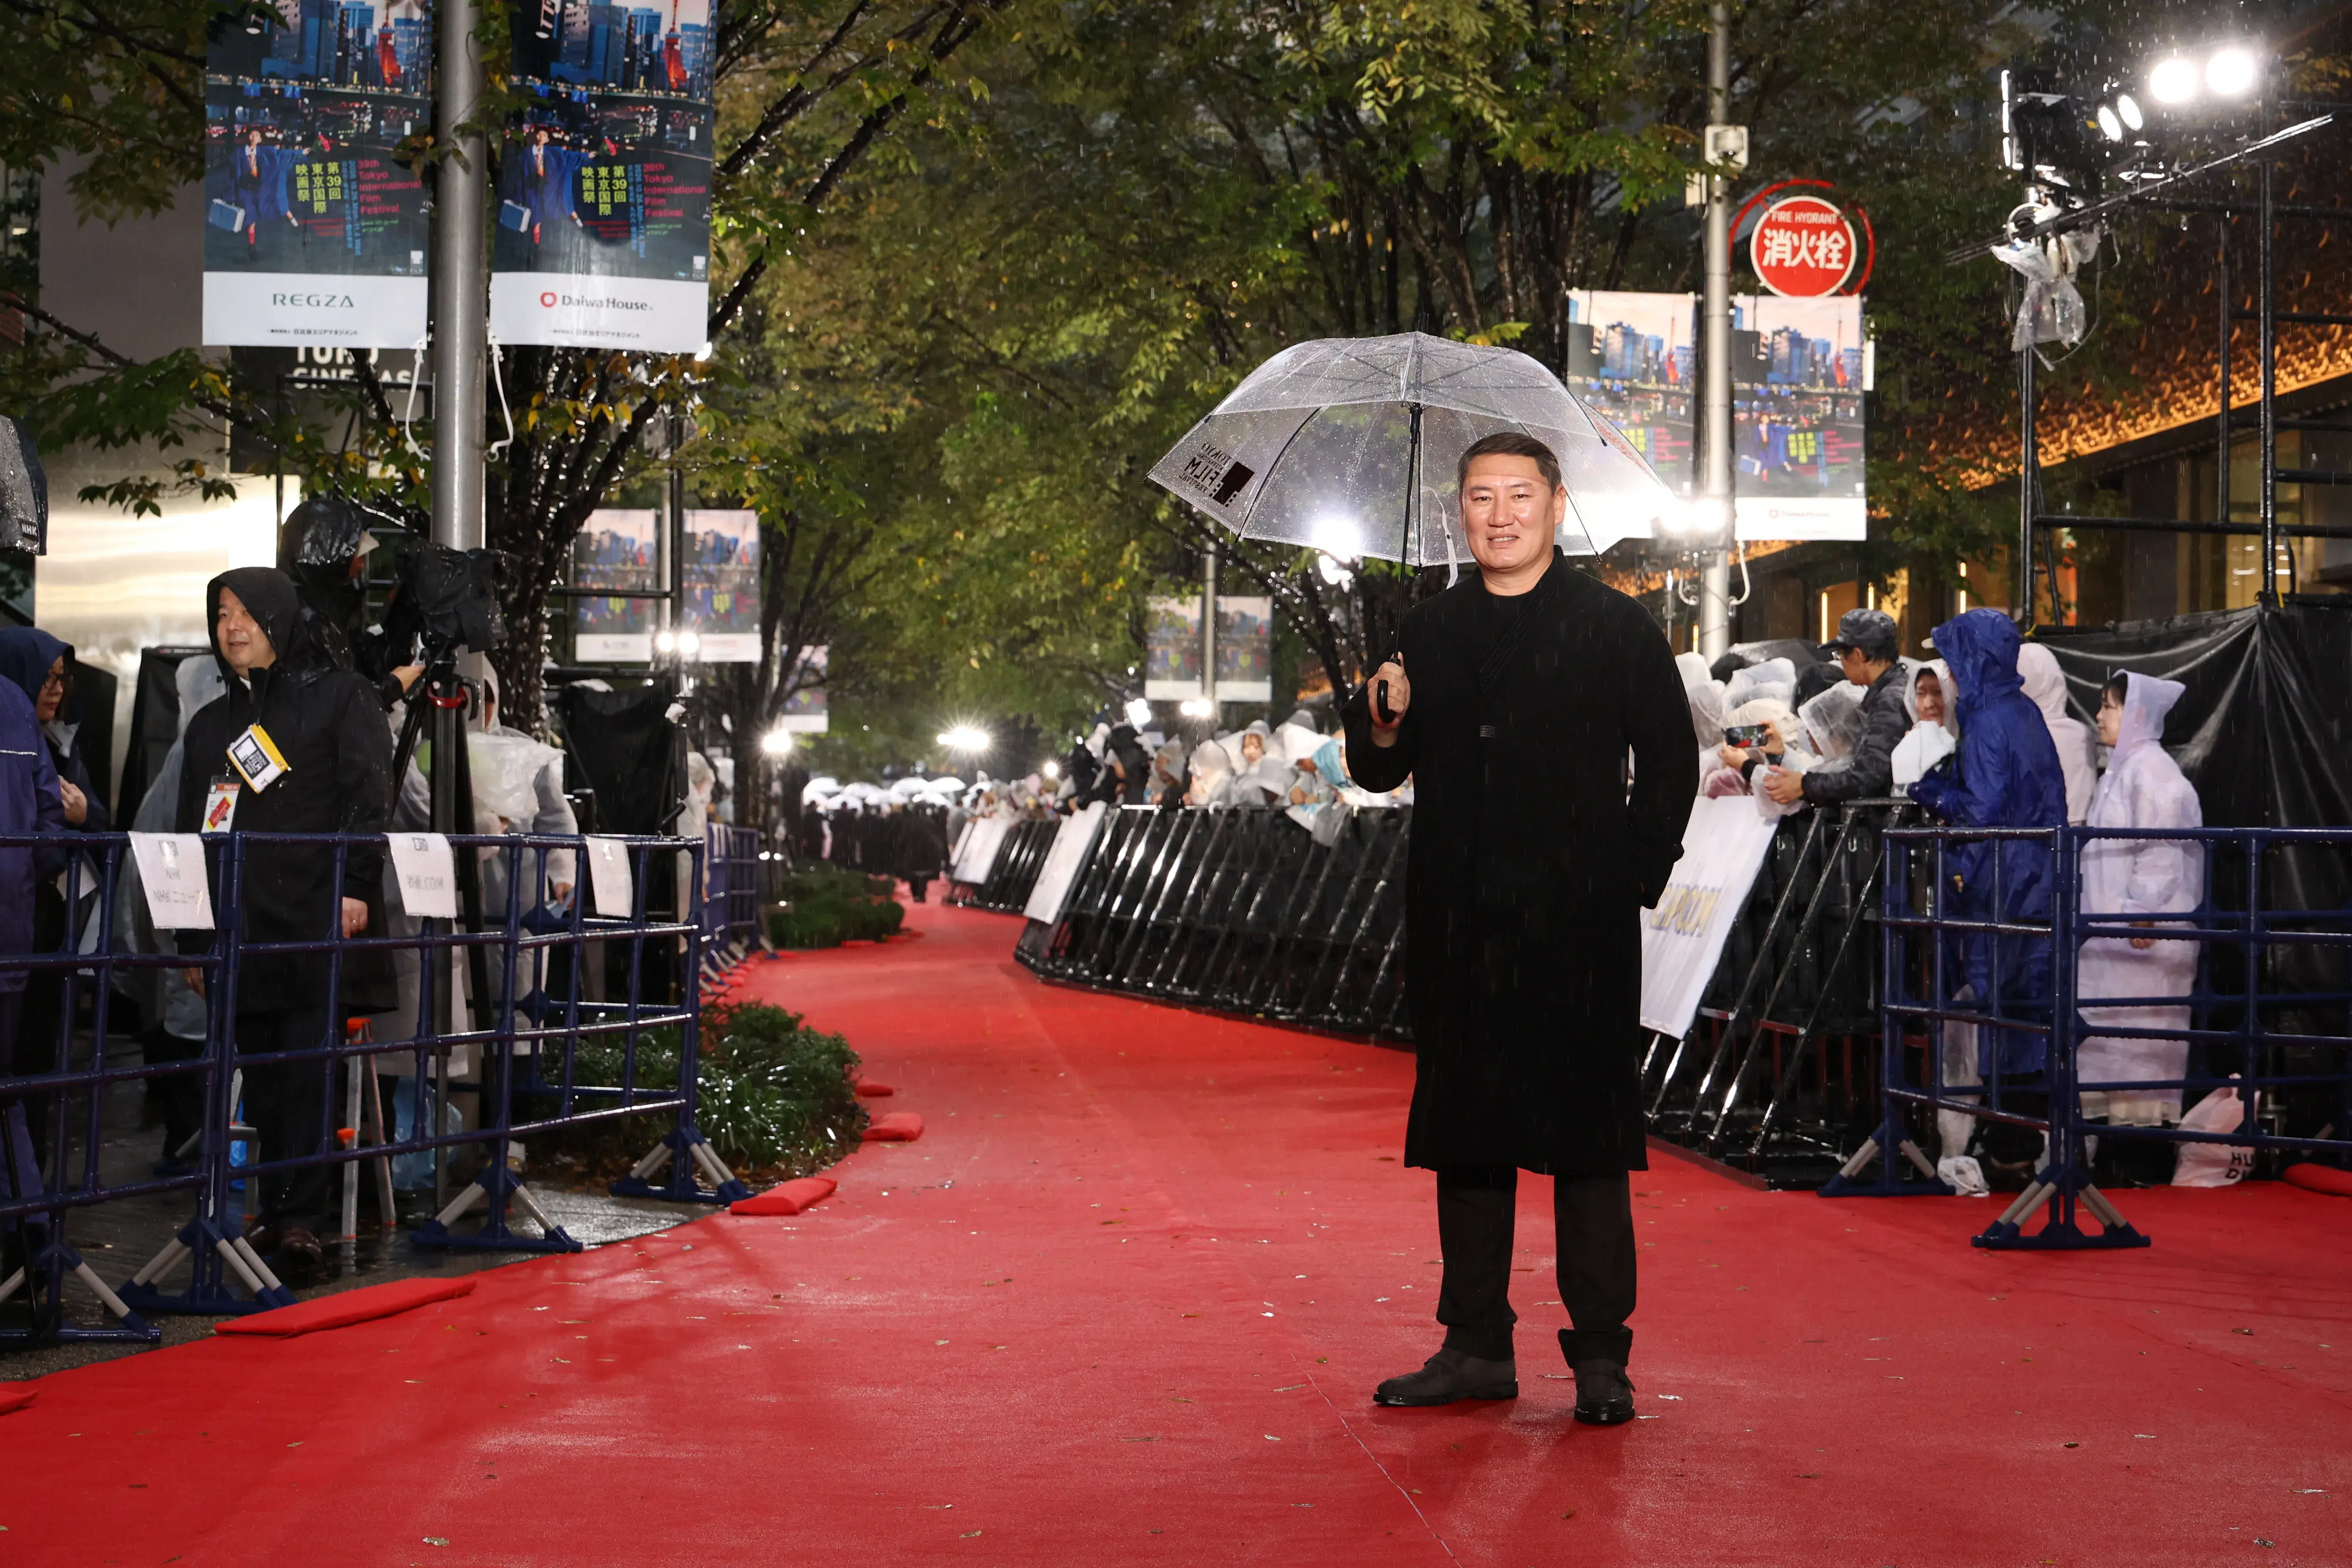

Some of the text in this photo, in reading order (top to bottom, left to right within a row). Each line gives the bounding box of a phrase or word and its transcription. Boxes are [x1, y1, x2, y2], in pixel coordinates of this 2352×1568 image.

[358, 171, 389, 181] Tokyo
[643, 174, 674, 184] Tokyo
[1771, 211, 1838, 225] FIRE HYDRANT
[1762, 228, 1847, 270] 消火栓
[272, 293, 354, 308] REGZA
[562, 295, 648, 310] Daiwa House
[21, 523, 37, 536] NHK
